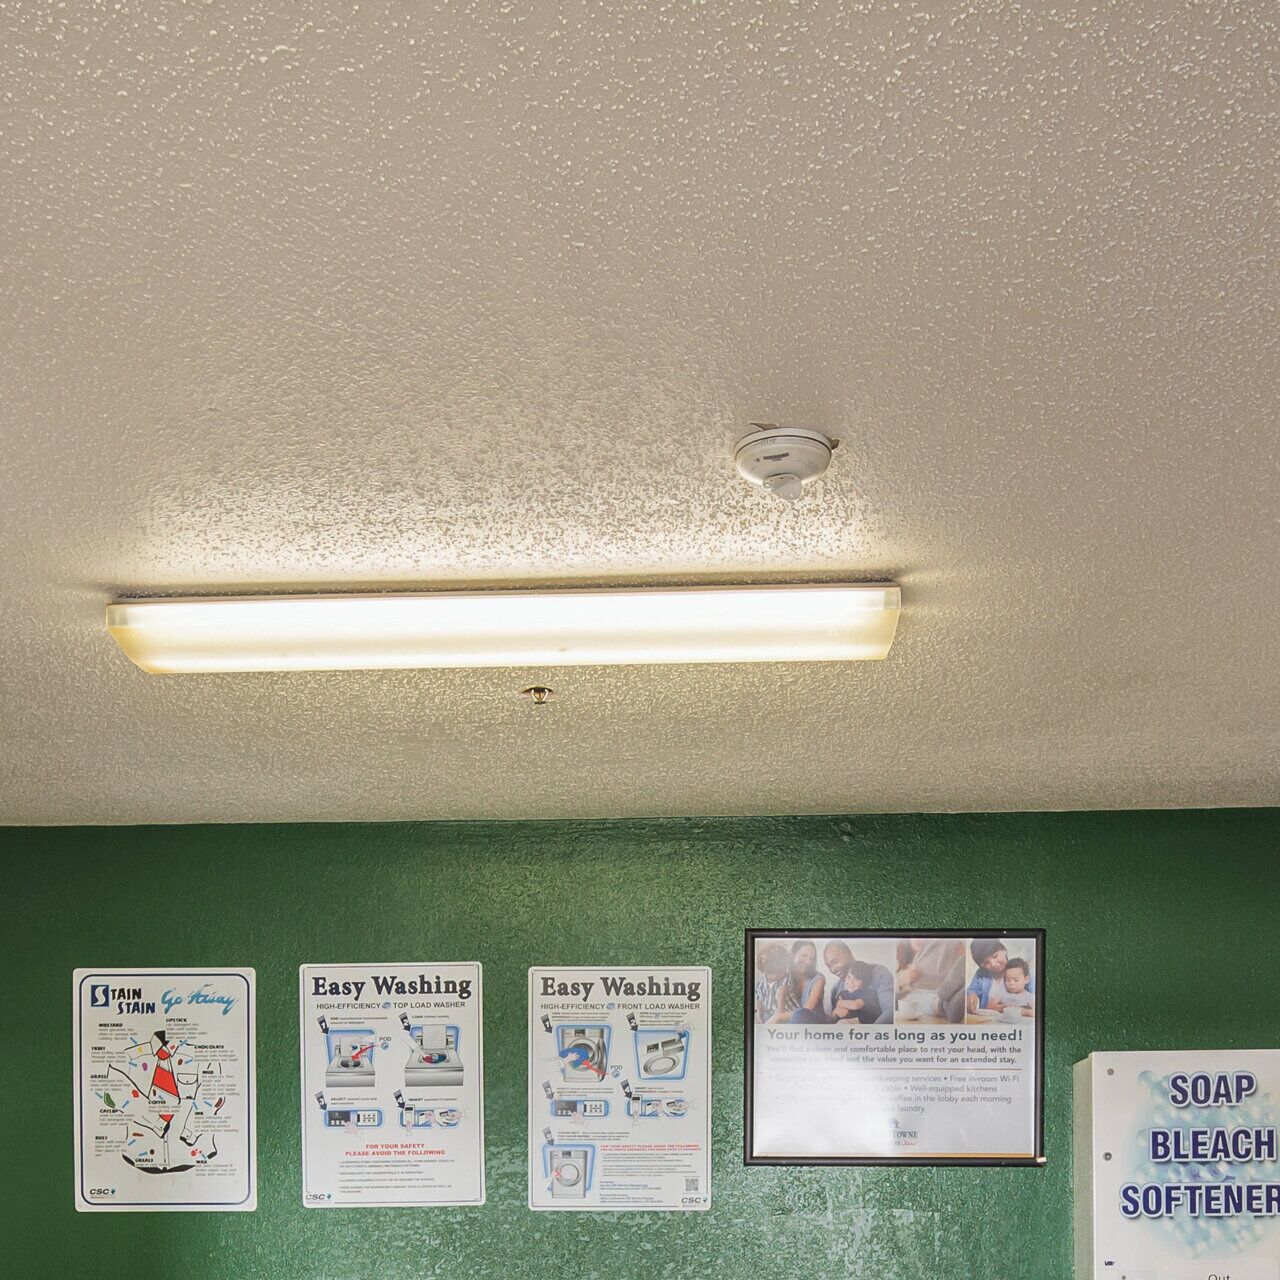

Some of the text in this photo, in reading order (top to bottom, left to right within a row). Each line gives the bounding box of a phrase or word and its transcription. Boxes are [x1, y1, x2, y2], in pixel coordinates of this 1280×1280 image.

[312, 975, 472, 1001] Easy Washing
[540, 975, 701, 1002] Easy Washing
[161, 989, 183, 1015] Go
[316, 1002, 381, 1010] HIGH-EFFICIENCY
[433, 1001, 466, 1009] WASHER
[117, 1001, 156, 1016] STAIN
[767, 1029, 1023, 1044] Your home for as long as you need!
[834, 1045, 848, 1053] and
[850, 1045, 896, 1053] comfortable
[898, 1045, 919, 1054] place
[947, 1047, 965, 1055] your
[967, 1046, 988, 1055] head,
[990, 1045, 1007, 1053] with
[1009, 1045, 1022, 1054] the
[862, 1055, 875, 1063] the
[877, 1055, 897, 1063] value
[899, 1057, 913, 1065] you
[936, 1055, 948, 1063] for
[961, 1055, 998, 1063] extended
[999, 1056, 1017, 1065] stay.
[950, 1075, 967, 1083] Free
[968, 1075, 998, 1083] in-room
[1000, 1075, 1020, 1083] Wi-Fi
[910, 1085, 997, 1094] Well-equipped kitchens
[1170, 1074, 1255, 1105] SOAP
[923, 1095, 936, 1103] the
[937, 1095, 959, 1104] lobby
[960, 1095, 978, 1103] each
[981, 1095, 1012, 1105] morning
[897, 1105, 926, 1114] laundry
[1150, 1128, 1276, 1160] BLEACH
